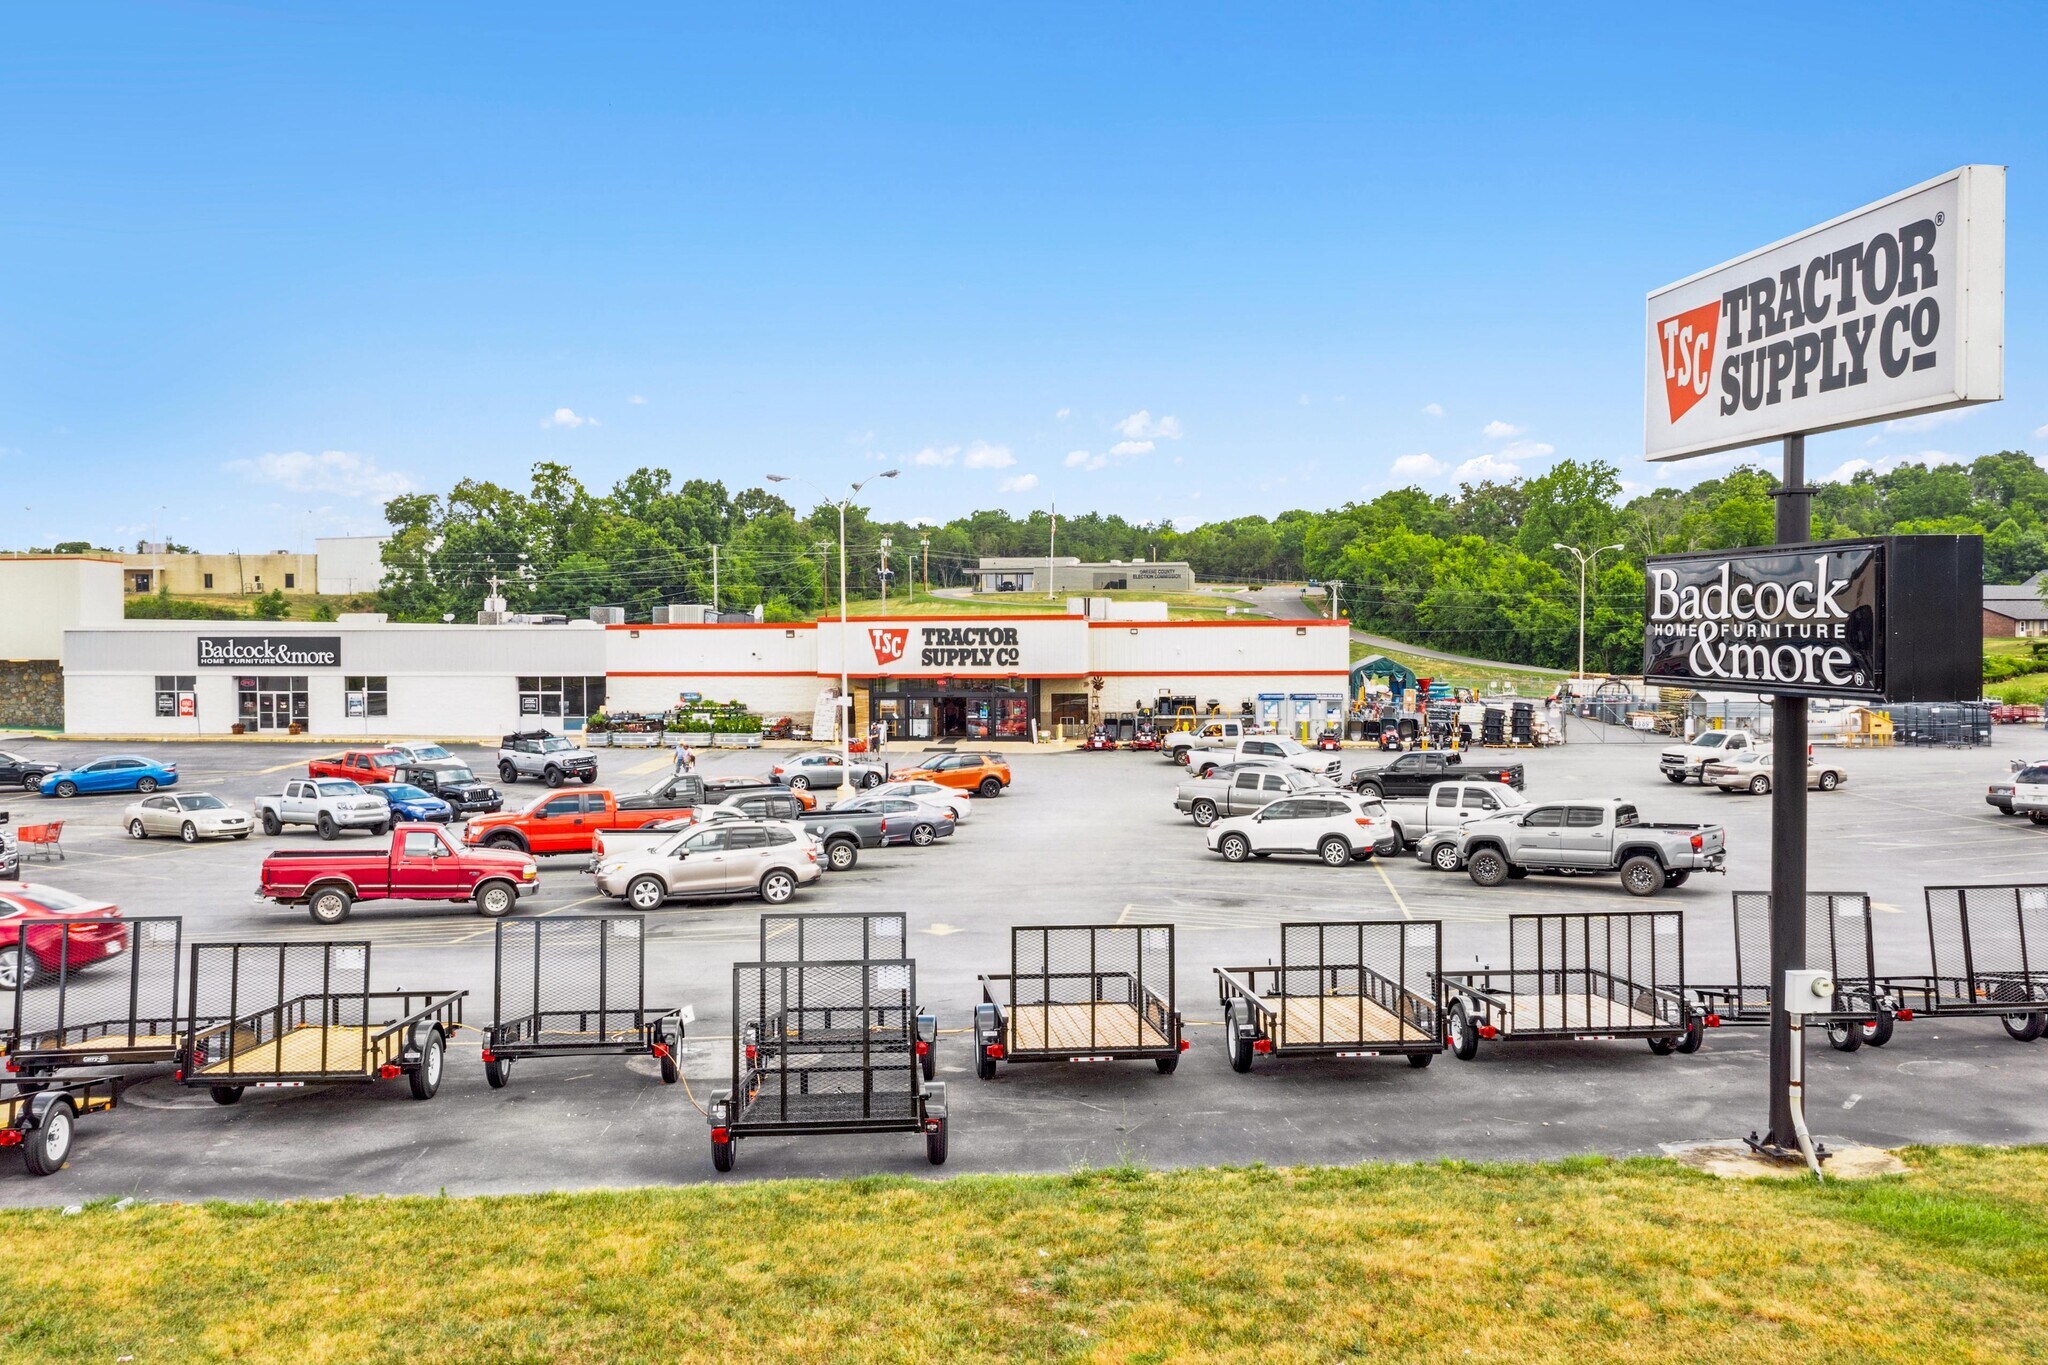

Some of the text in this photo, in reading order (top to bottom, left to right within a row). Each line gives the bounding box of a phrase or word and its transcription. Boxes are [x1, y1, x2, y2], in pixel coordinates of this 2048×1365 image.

[1722, 218, 1938, 349] TRACTOR
[1664, 319, 1710, 396] TSC
[1720, 315, 1876, 417] SUPPLY
[1651, 554, 1849, 620] Badcock
[200, 639, 335, 664] Badcock &more
[872, 629, 902, 658] TSC
[922, 627, 1019, 646] TRACTOR
[1654, 623, 1846, 639] HOME FURNITURE
[1689, 620, 1853, 686] &more
[922, 648, 994, 666] SUPPLY
